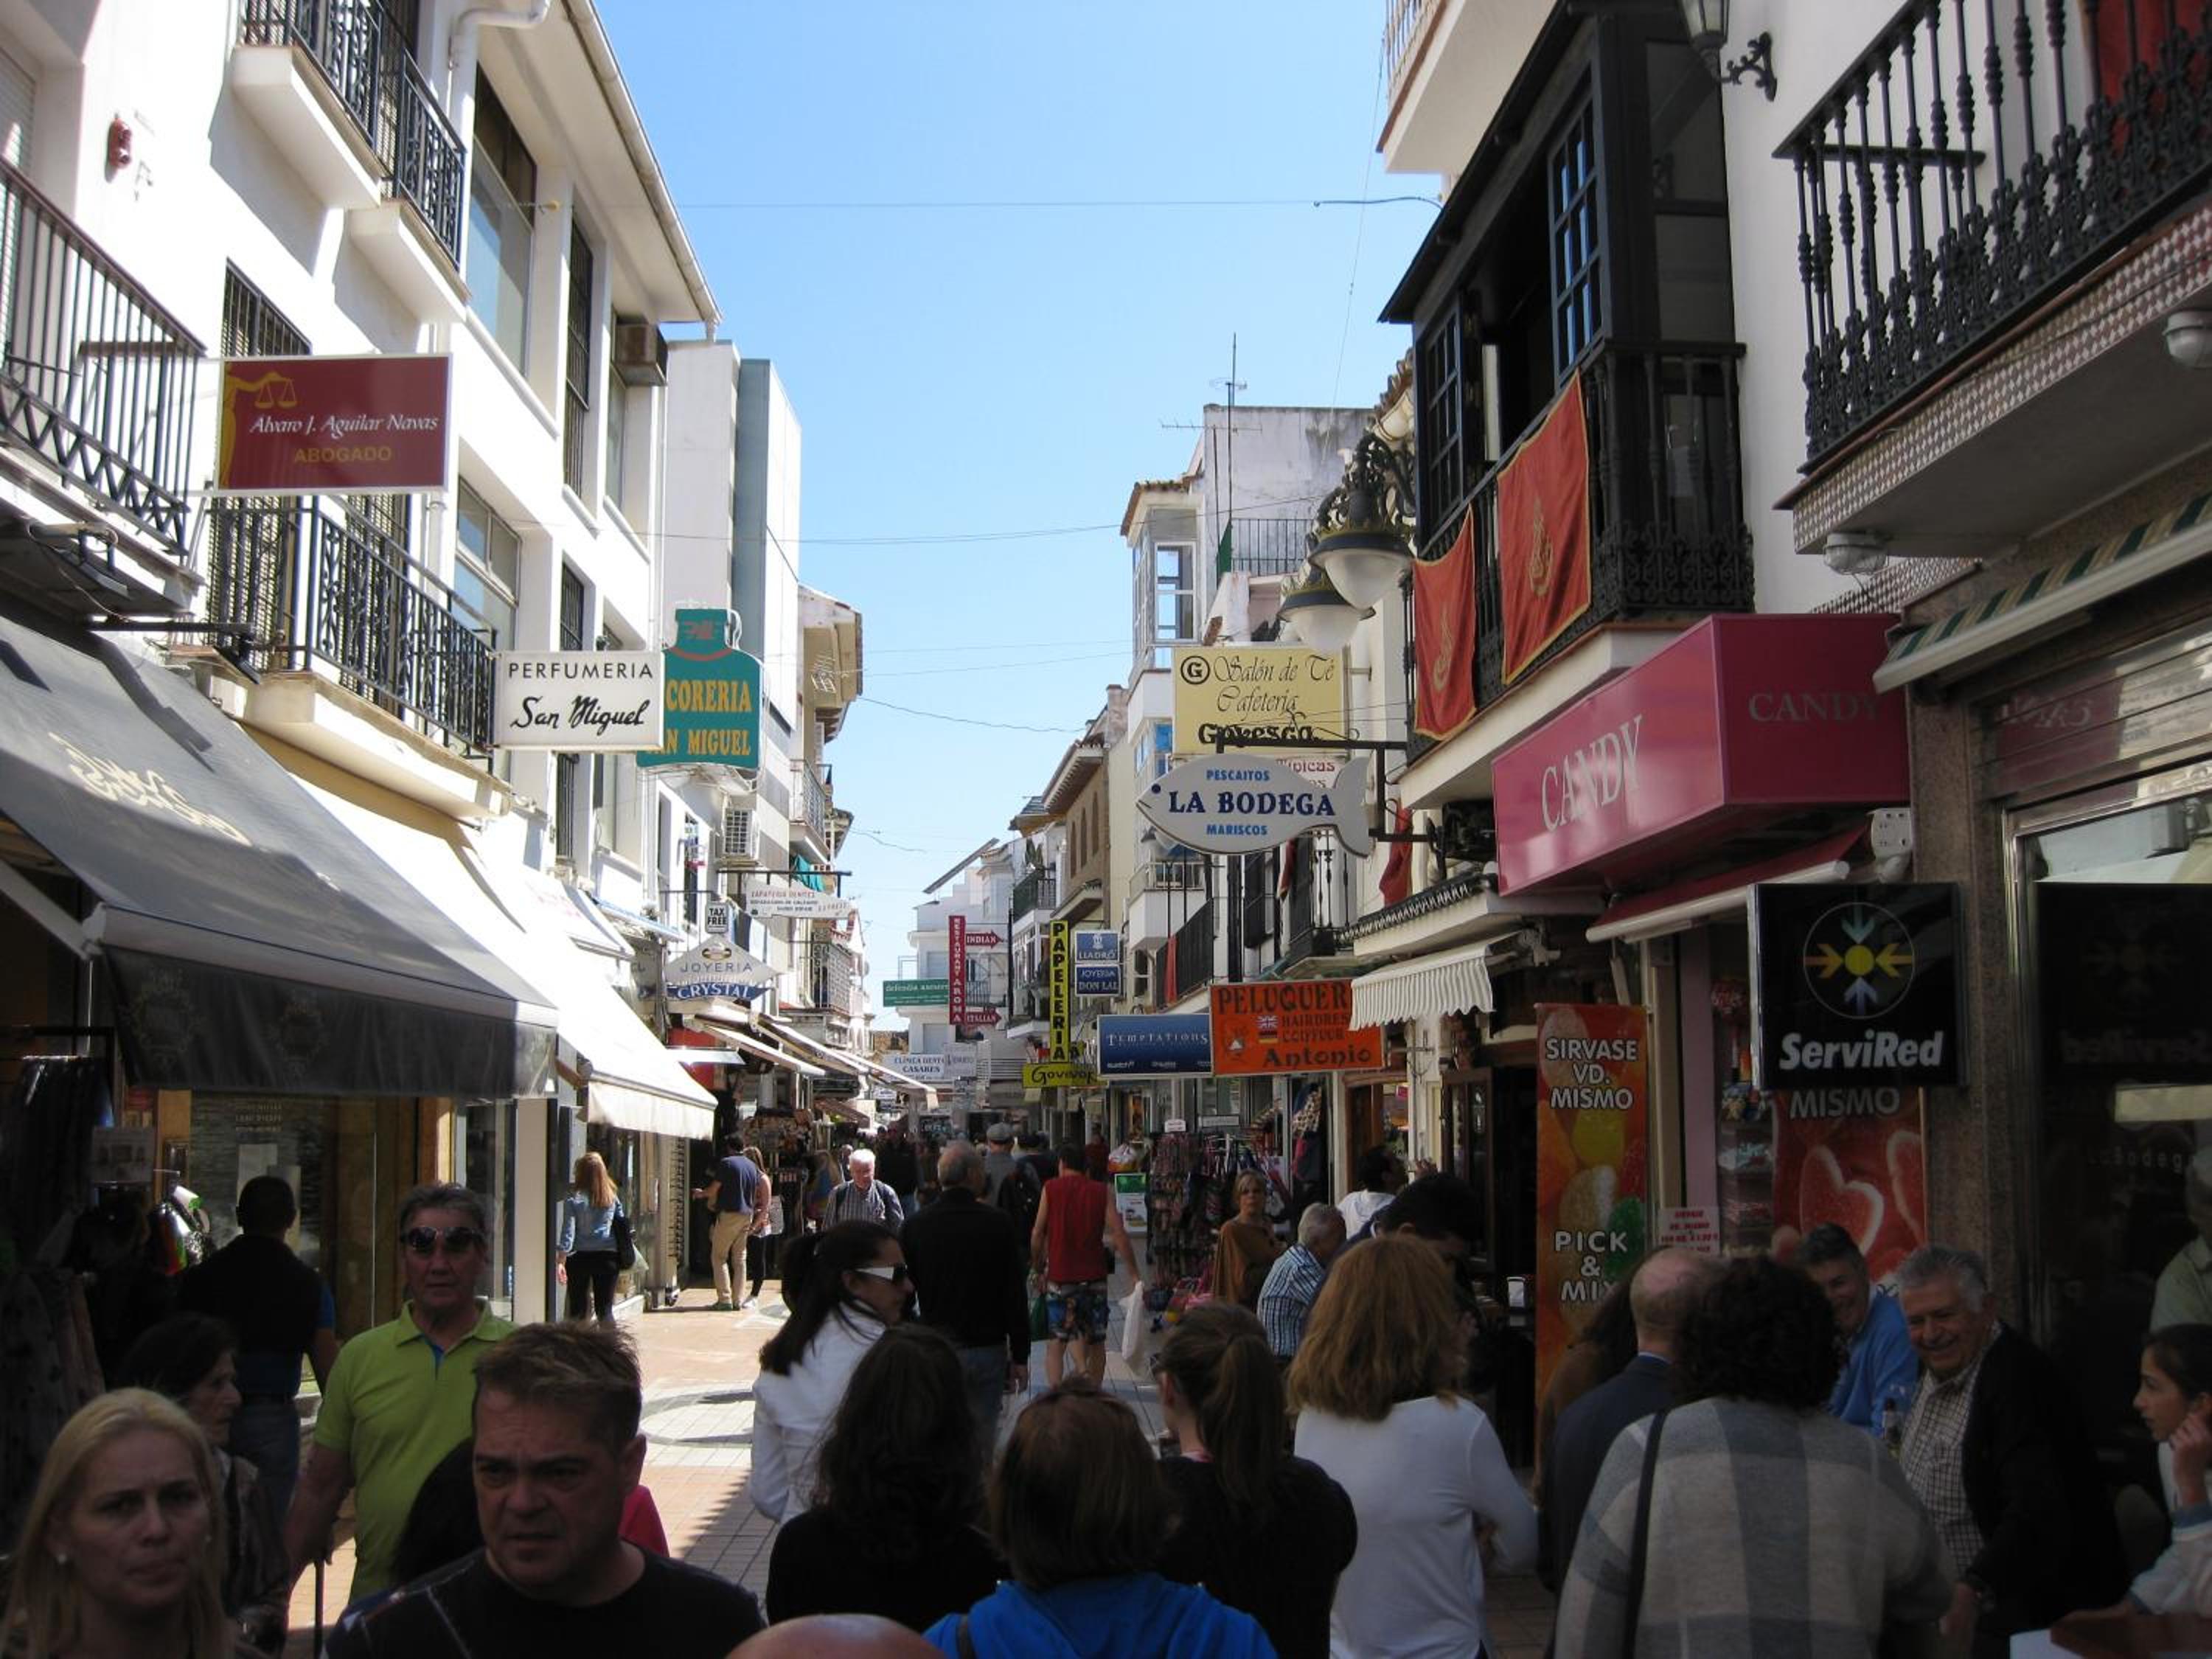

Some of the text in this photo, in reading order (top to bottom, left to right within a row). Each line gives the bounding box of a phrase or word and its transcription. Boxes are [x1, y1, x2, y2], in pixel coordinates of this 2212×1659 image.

[250, 415, 302, 434] Alvaro
[306, 415, 316, 435] J.
[321, 414, 383, 439] Aguilar
[293, 446, 392, 462] ABOGADO
[508, 662, 653, 679] PERFUMERIA
[1213, 653, 1336, 682] Salón de Té
[665, 679, 751, 713] CORERIA
[1748, 692, 1882, 723] CANDY
[510, 695, 651, 737] San Miguel
[687, 728, 751, 757] MIGUEL
[1206, 770, 1270, 782] PESCAITOS
[1541, 714, 1643, 832] CANDY
[1168, 790, 1335, 816] LA BODEGA
[1206, 824, 1267, 835] MARISCOS
[707, 917, 727, 925] FREE
[709, 908, 725, 917] TAX
[679, 961, 753, 973] JOYERIA
[1082, 970, 1115, 978] JOYERIA
[677, 982, 751, 1000] CRYSTAL
[953, 978, 962, 1022] AROMA
[1052, 922, 1066, 1060] PAPELERIA
[1217, 982, 1347, 1015] PELUQUER
[1282, 1013, 1350, 1028] HAIRDRES
[1263, 1044, 1371, 1068] Antonio
[1545, 1037, 1638, 1062] SIRVASE
[1778, 1029, 1944, 1071] ServiRed
[1572, 1063, 1611, 1086] VD.
[1550, 1087, 1634, 1110] MISMO
[1790, 1087, 1901, 1119] MISMO
[1554, 1230, 1629, 1253] PICK
[1580, 1255, 1601, 1278] &
